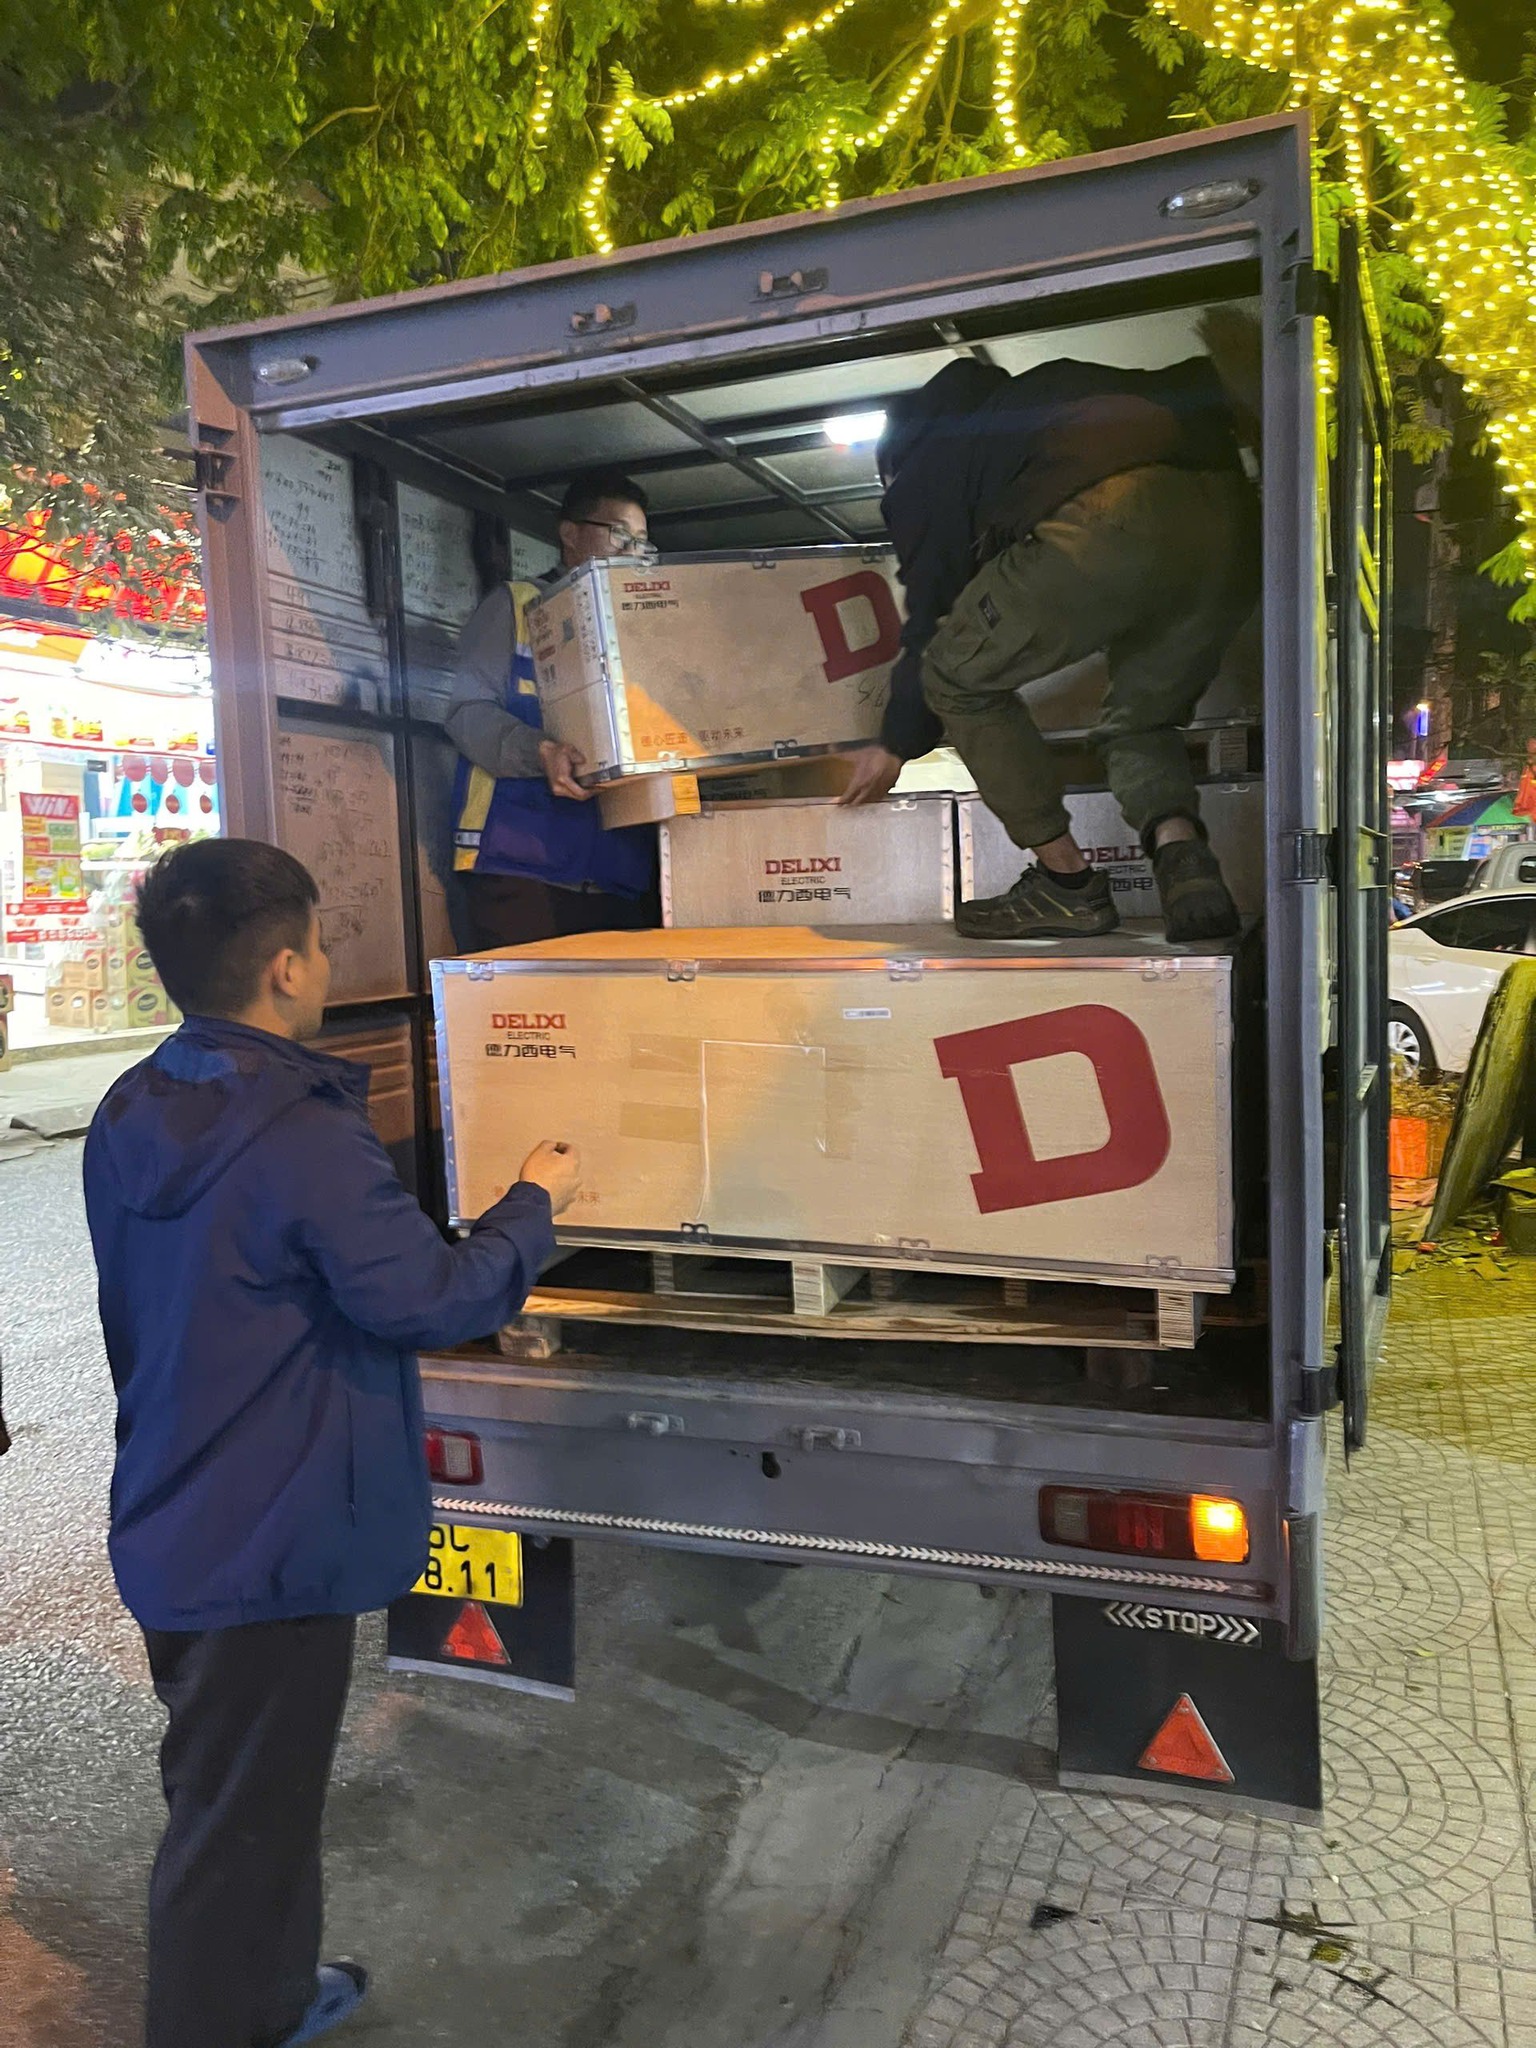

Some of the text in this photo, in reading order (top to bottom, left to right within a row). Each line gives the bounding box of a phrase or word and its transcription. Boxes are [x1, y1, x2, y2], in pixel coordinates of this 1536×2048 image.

[765, 857, 842, 875] DELIXI
[781, 876, 826, 885] ELECTRIC
[759, 887, 851, 902] 德力西电气
[492, 1014, 567, 1029] DELIXI
[507, 1031, 551, 1040] ELECTRIC
[485, 1043, 576, 1059] 德力西电气
[933, 1004, 1171, 1214] D
[1145, 1607, 1218, 1635] STOP
